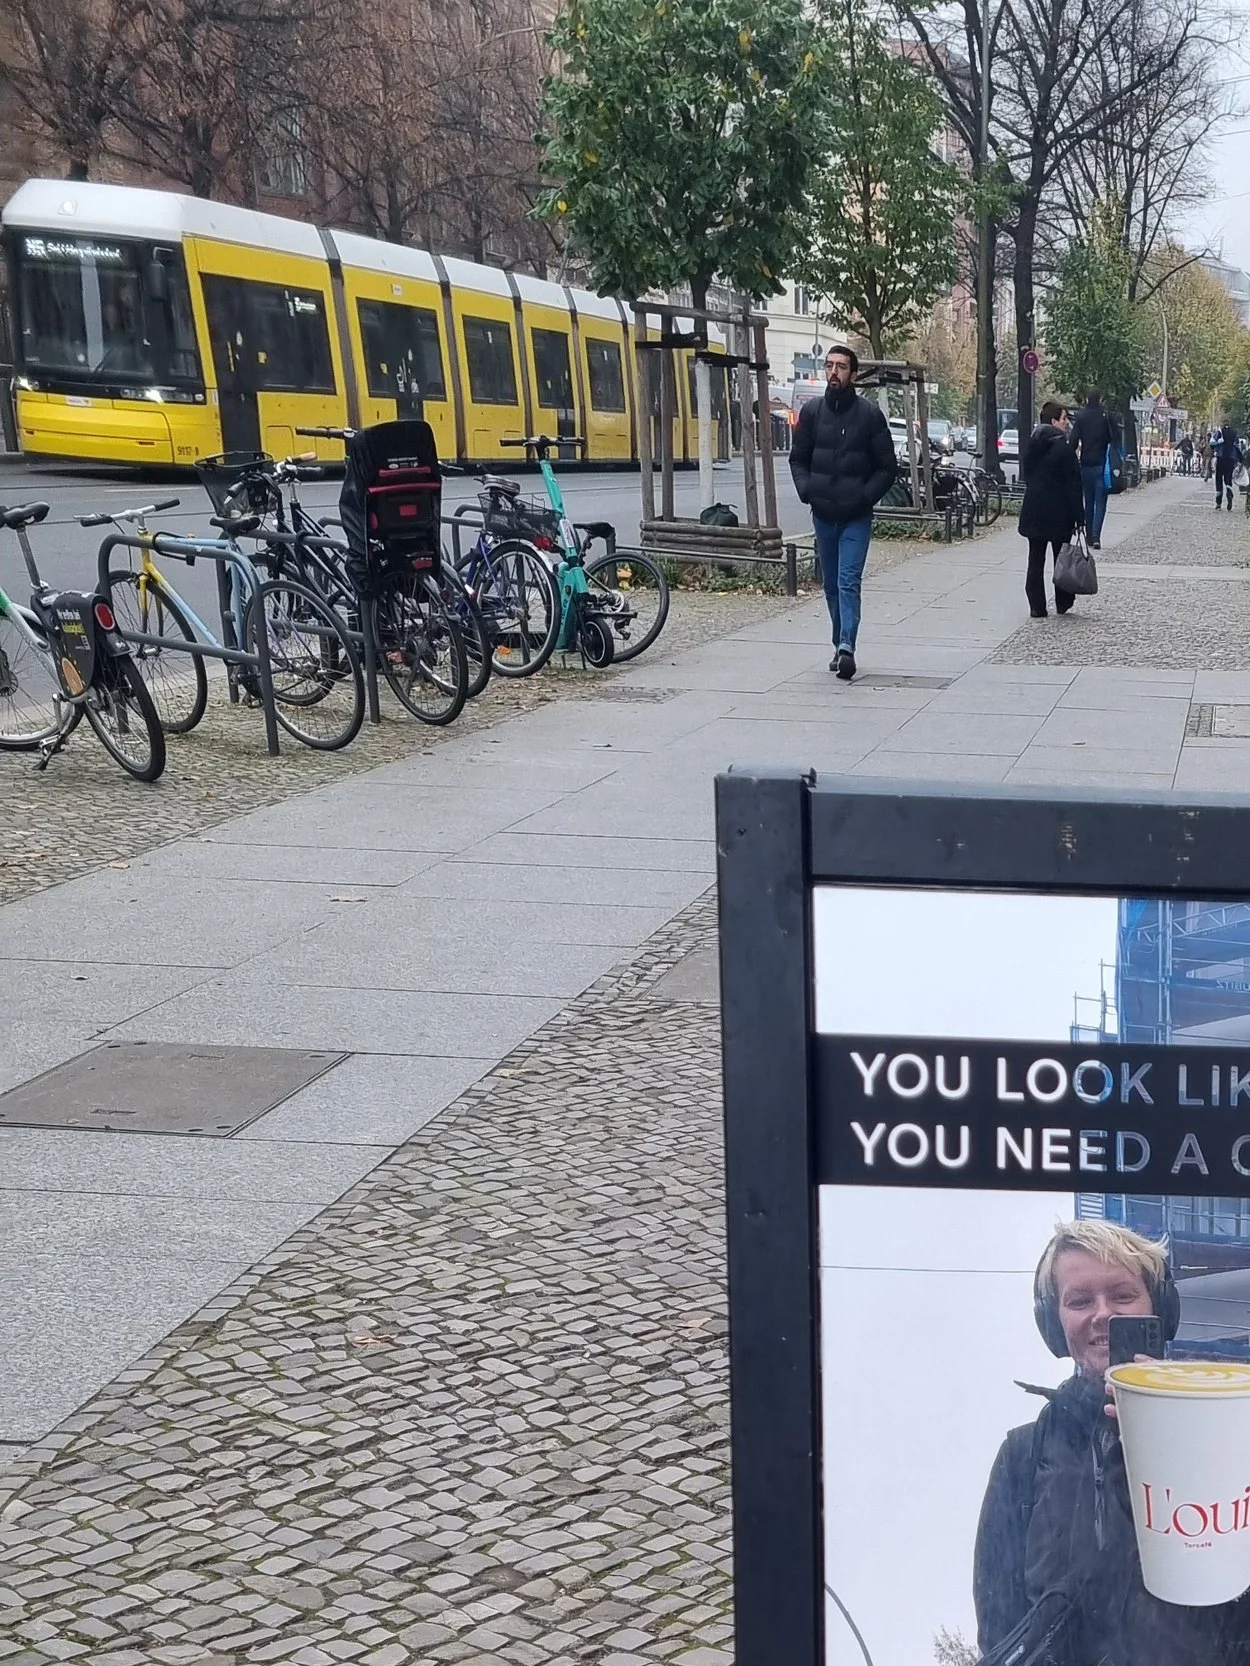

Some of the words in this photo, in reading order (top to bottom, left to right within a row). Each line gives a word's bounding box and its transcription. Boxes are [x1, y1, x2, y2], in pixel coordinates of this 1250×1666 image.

[849, 1051, 970, 1100] YOU
[996, 1056, 1154, 1105] LOOK
[849, 1121, 970, 1168] YOU
[996, 1126, 1151, 1172] NEED
[1170, 1133, 1210, 1175] A
[1142, 1482, 1250, 1537] L'oui
